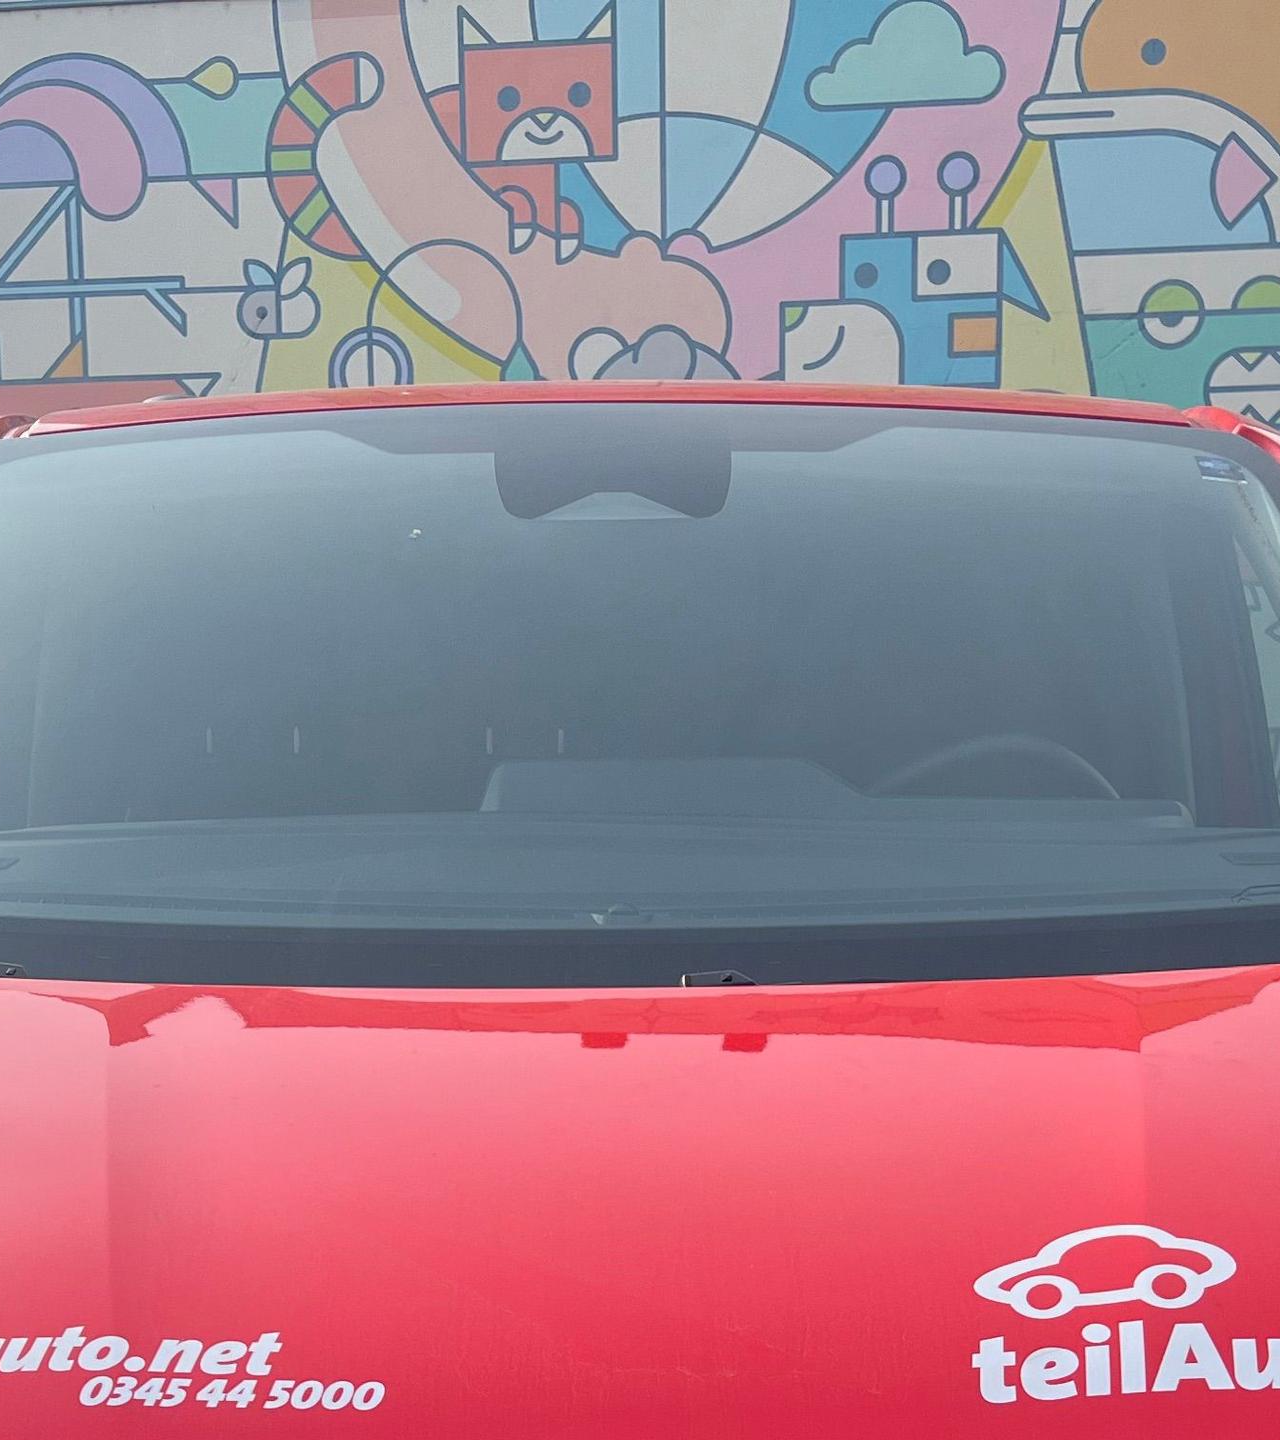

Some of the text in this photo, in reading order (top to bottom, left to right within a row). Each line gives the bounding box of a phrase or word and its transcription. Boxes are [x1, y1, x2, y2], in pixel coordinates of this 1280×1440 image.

[79, 1376, 386, 1411] 0345 44 5000
